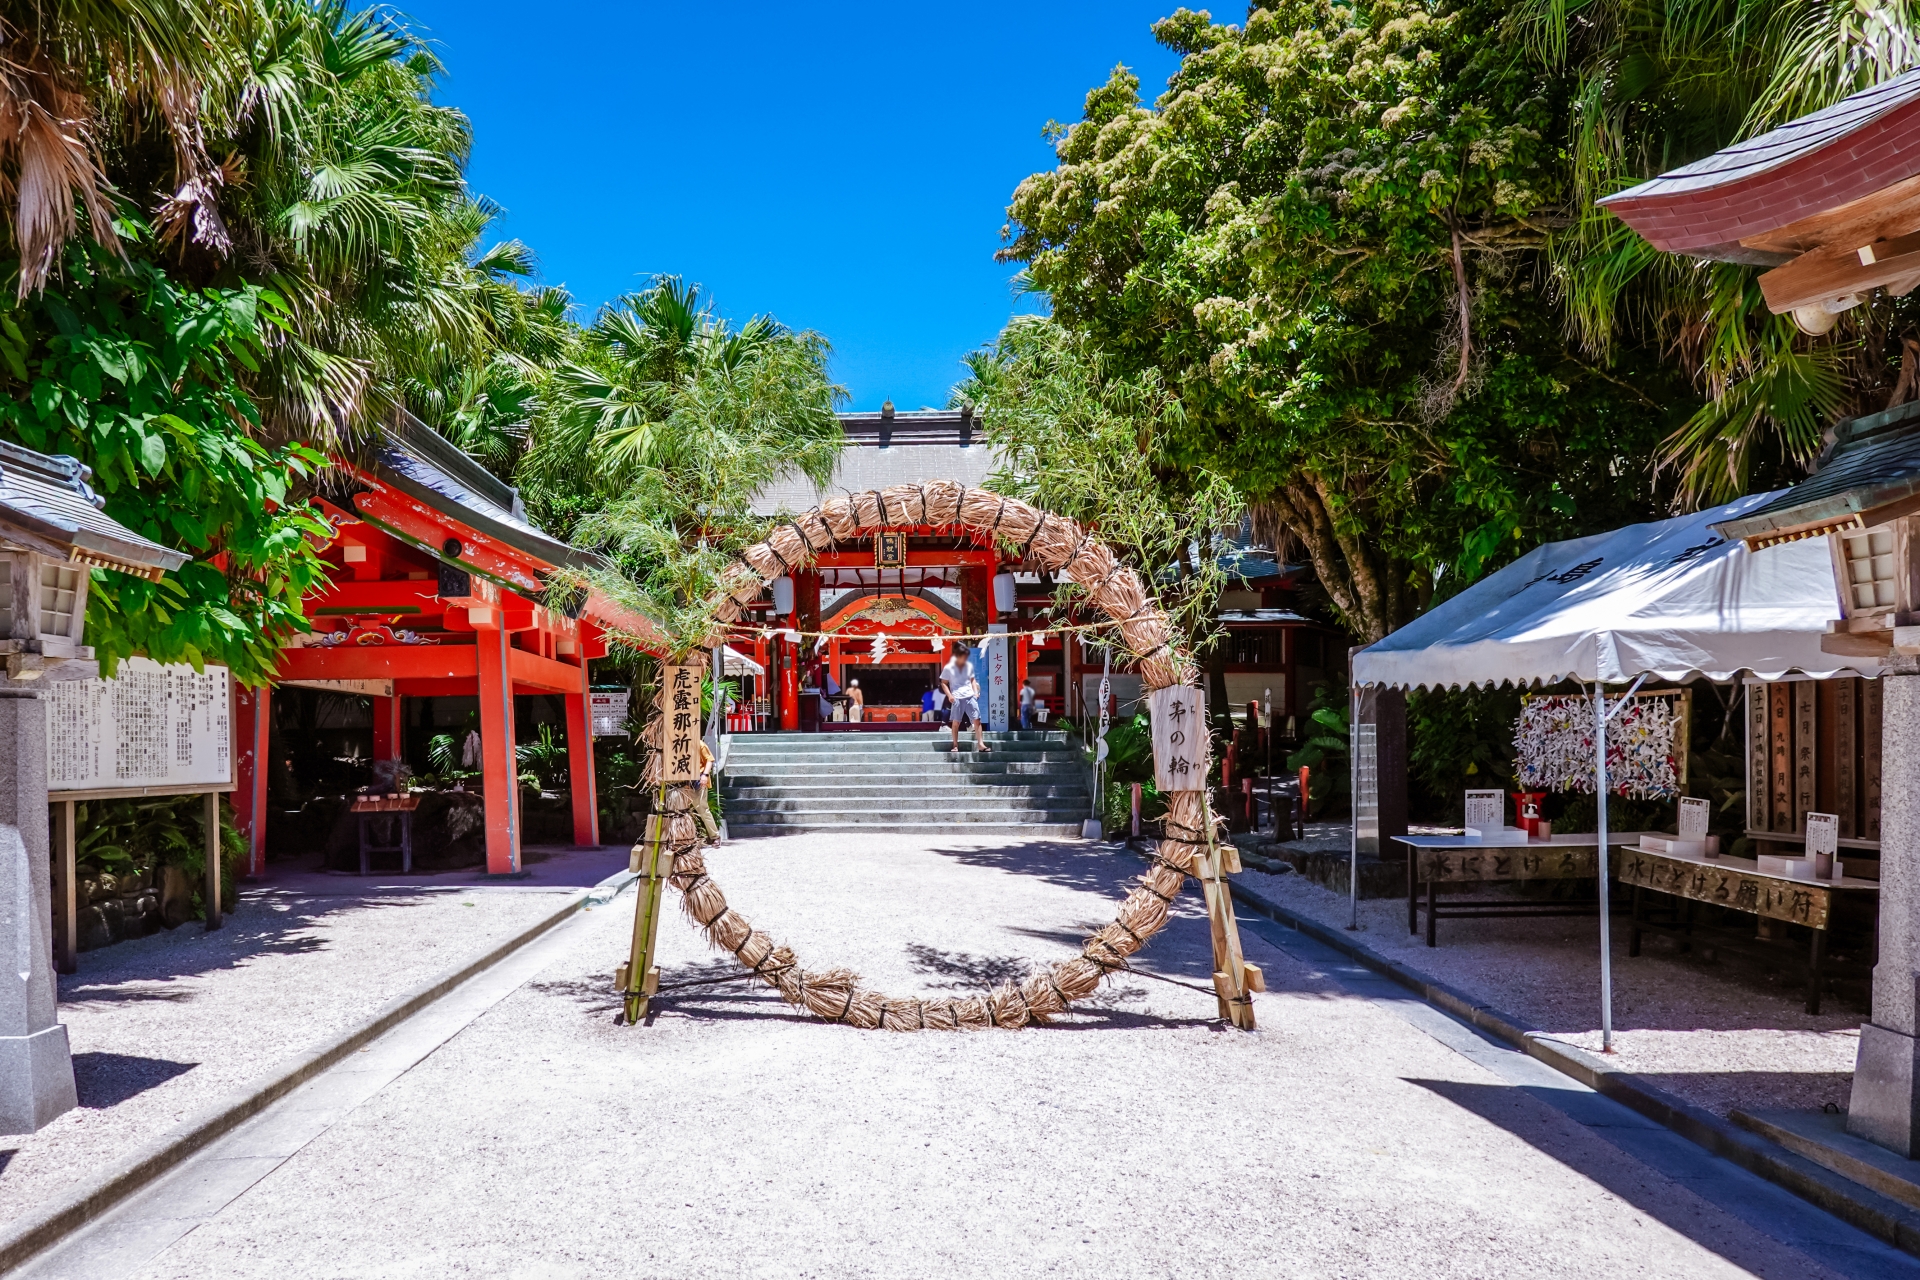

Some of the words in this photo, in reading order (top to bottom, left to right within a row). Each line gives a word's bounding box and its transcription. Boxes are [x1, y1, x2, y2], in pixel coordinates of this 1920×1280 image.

[993, 652, 1004, 686] 七夕祭
[692, 676, 700, 725] コロナ
[1754, 685, 1764, 724] 二十一日
[1774, 685, 1785, 719] 十八日
[1838, 680, 1850, 715] 三十日
[1868, 681, 1878, 715] 三十日
[672, 668, 692, 775] 虎露那祈滅
[1168, 699, 1190, 775] 茅の輪
[1629, 859, 1814, 920] 水にとける願い符
